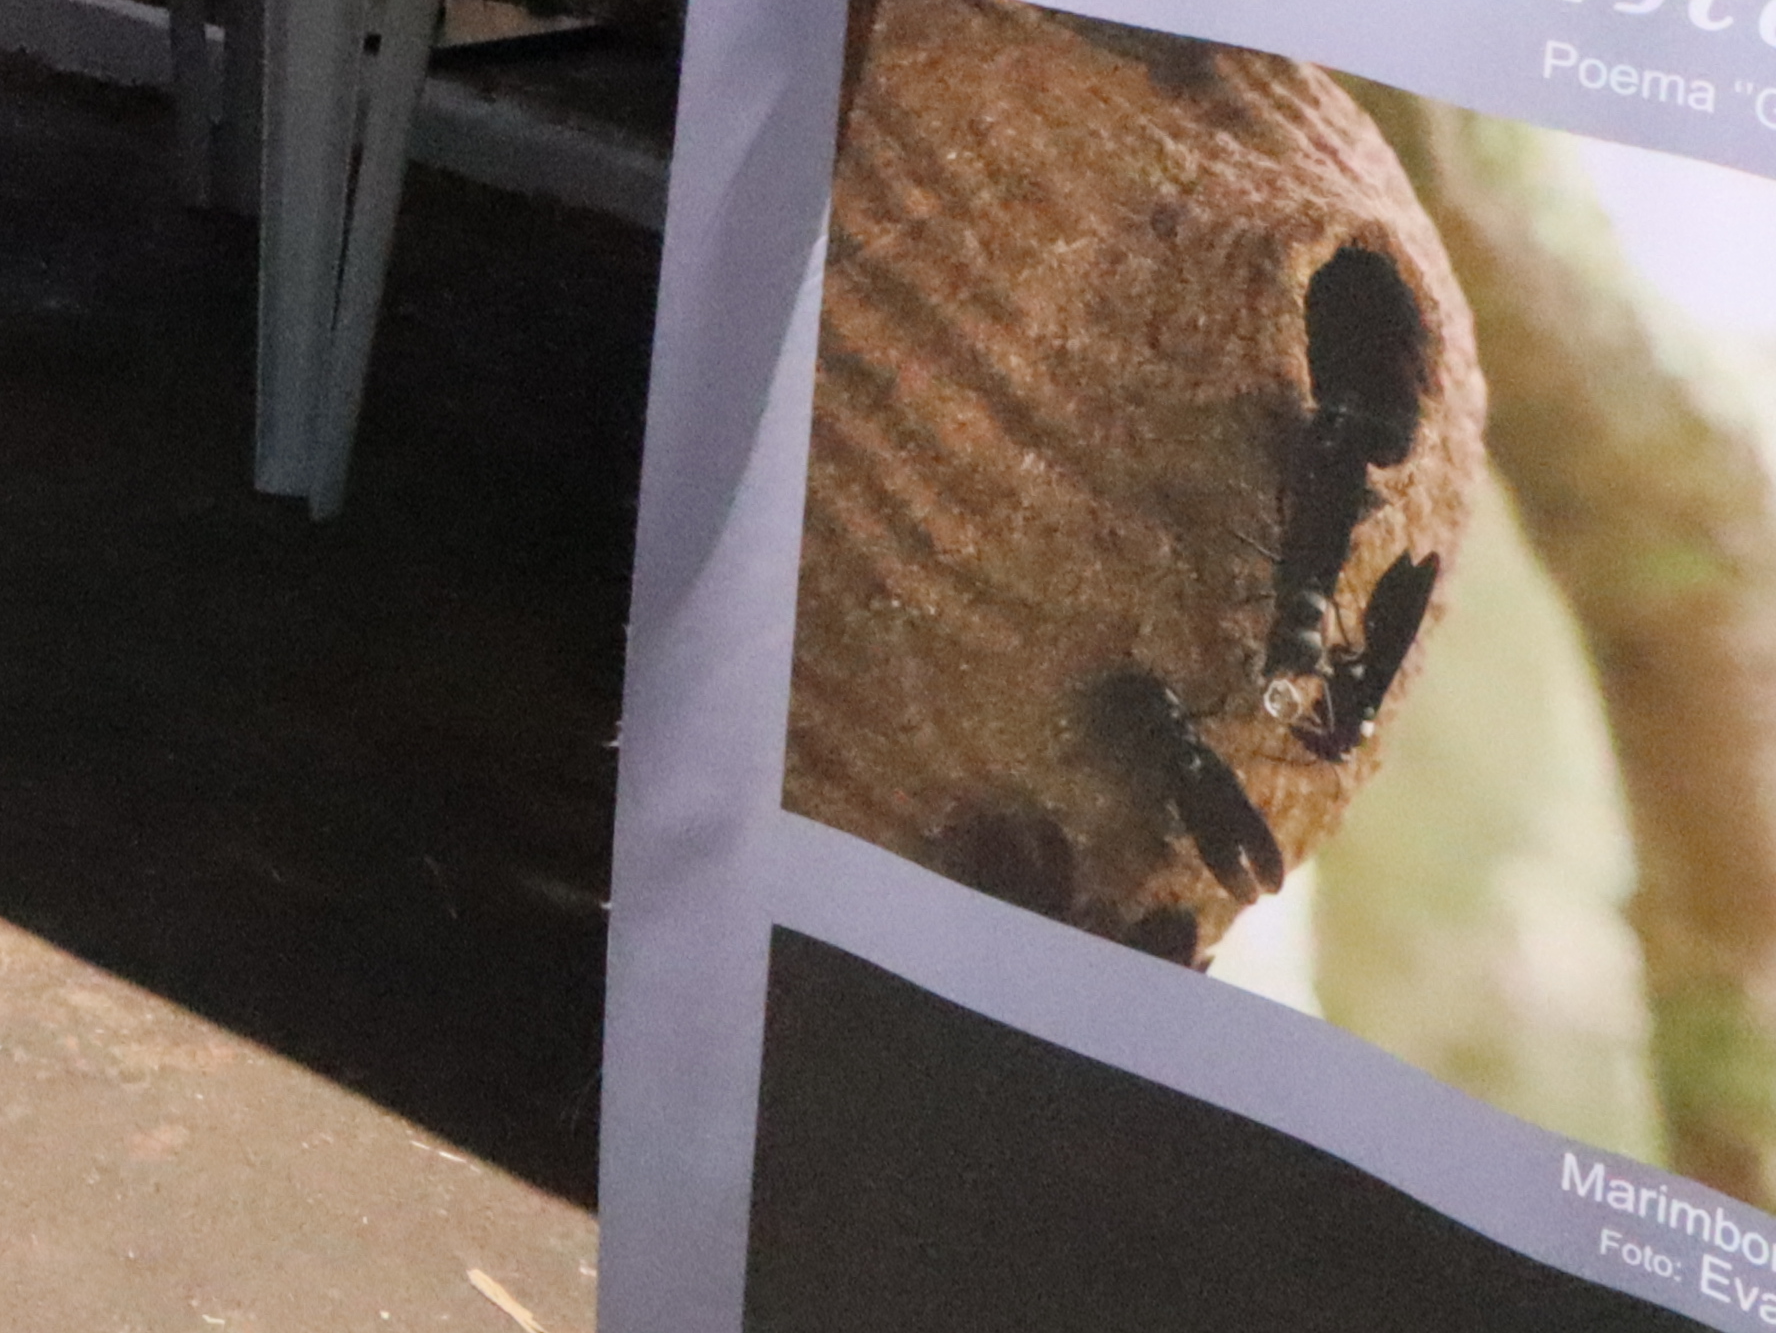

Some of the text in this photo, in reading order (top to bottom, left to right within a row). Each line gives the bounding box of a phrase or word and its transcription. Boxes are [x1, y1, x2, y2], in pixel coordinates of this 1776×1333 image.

[1542, 38, 1716, 114] Poema
[1560, 1151, 1776, 1273] Marimbo
[1599, 1227, 1683, 1283] Foto:
